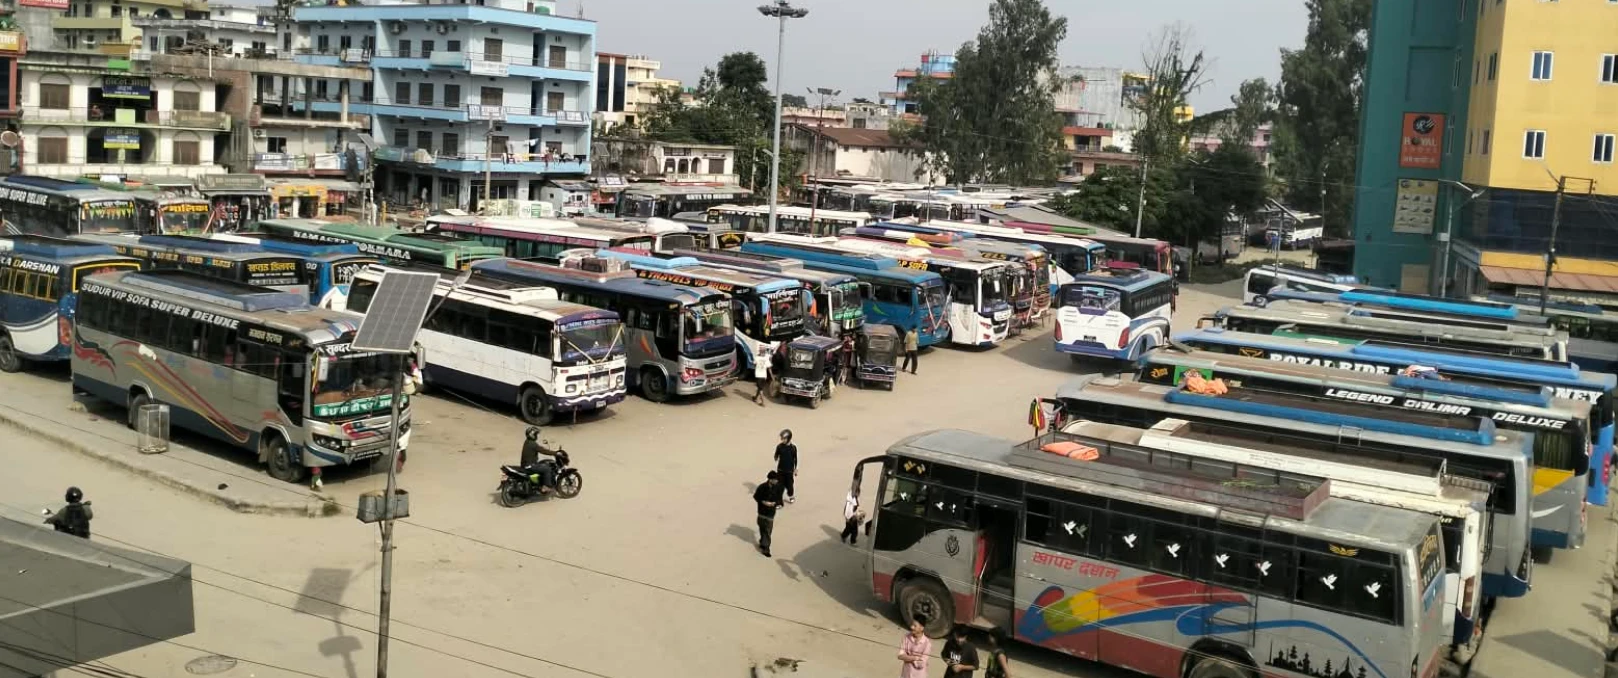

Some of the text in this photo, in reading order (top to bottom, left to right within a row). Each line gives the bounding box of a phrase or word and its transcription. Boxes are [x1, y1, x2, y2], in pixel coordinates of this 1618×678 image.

[9, 189, 27, 203] SUPER
[26, 192, 48, 206] DELUXE
[12, 258, 60, 275] DARSHAN
[907, 260, 928, 272] SOFA
[647, 270, 691, 286] TRAVELS
[81, 282, 240, 330] SUDUR VIP SOFA SUPER DELUXE
[1325, 388, 1395, 405] LEGEND
[1492, 411, 1567, 429] DELUXE
